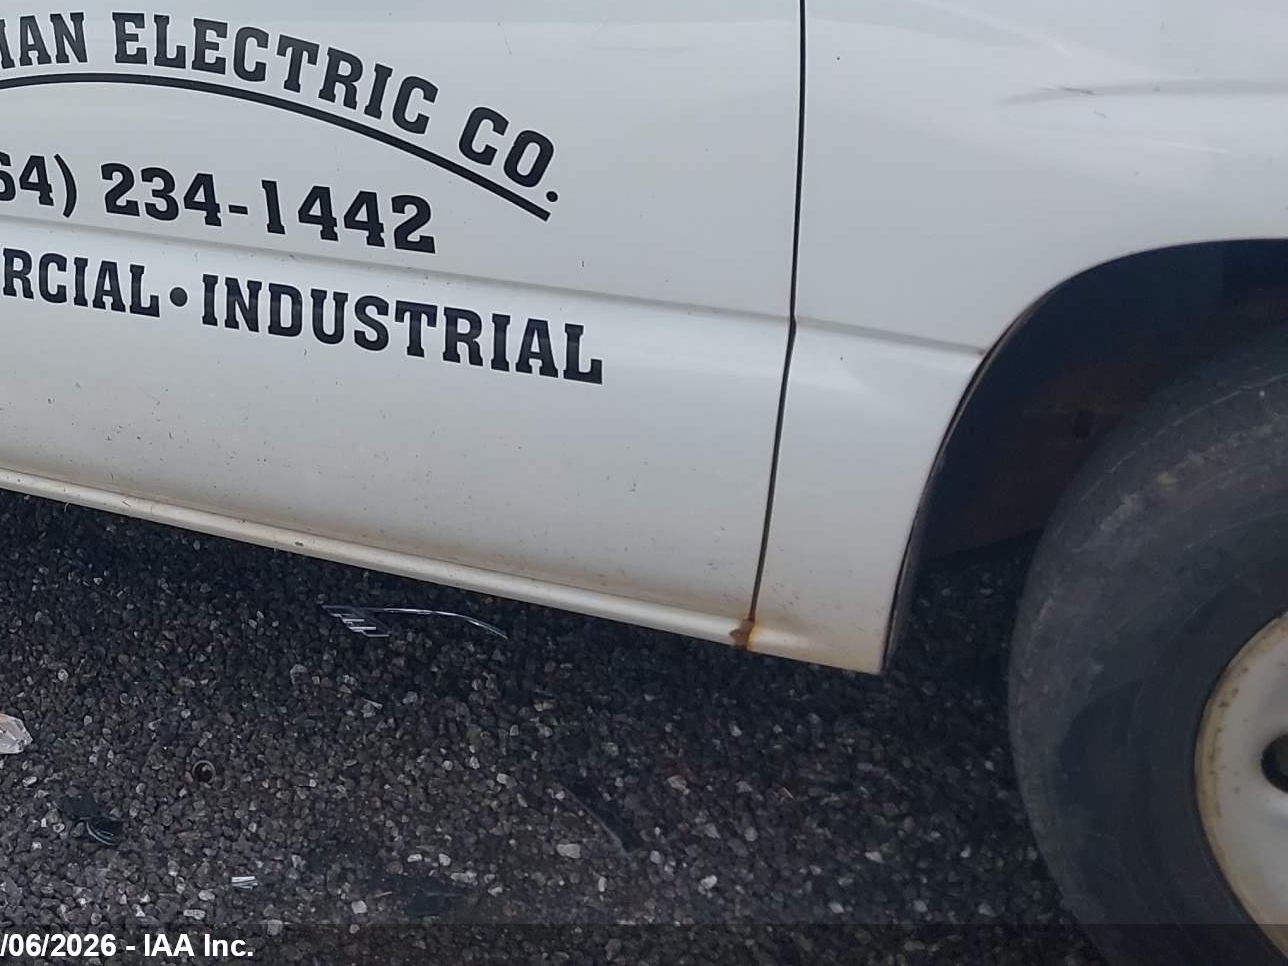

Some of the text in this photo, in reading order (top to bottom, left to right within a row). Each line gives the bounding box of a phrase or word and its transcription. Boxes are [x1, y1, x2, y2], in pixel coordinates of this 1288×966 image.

[111, 11, 439, 135] ELECTRIC
[458, 106, 559, 203] CO.
[100, 162, 436, 255] 234-1442
[201, 273, 603, 385] INDUSTRIAL
